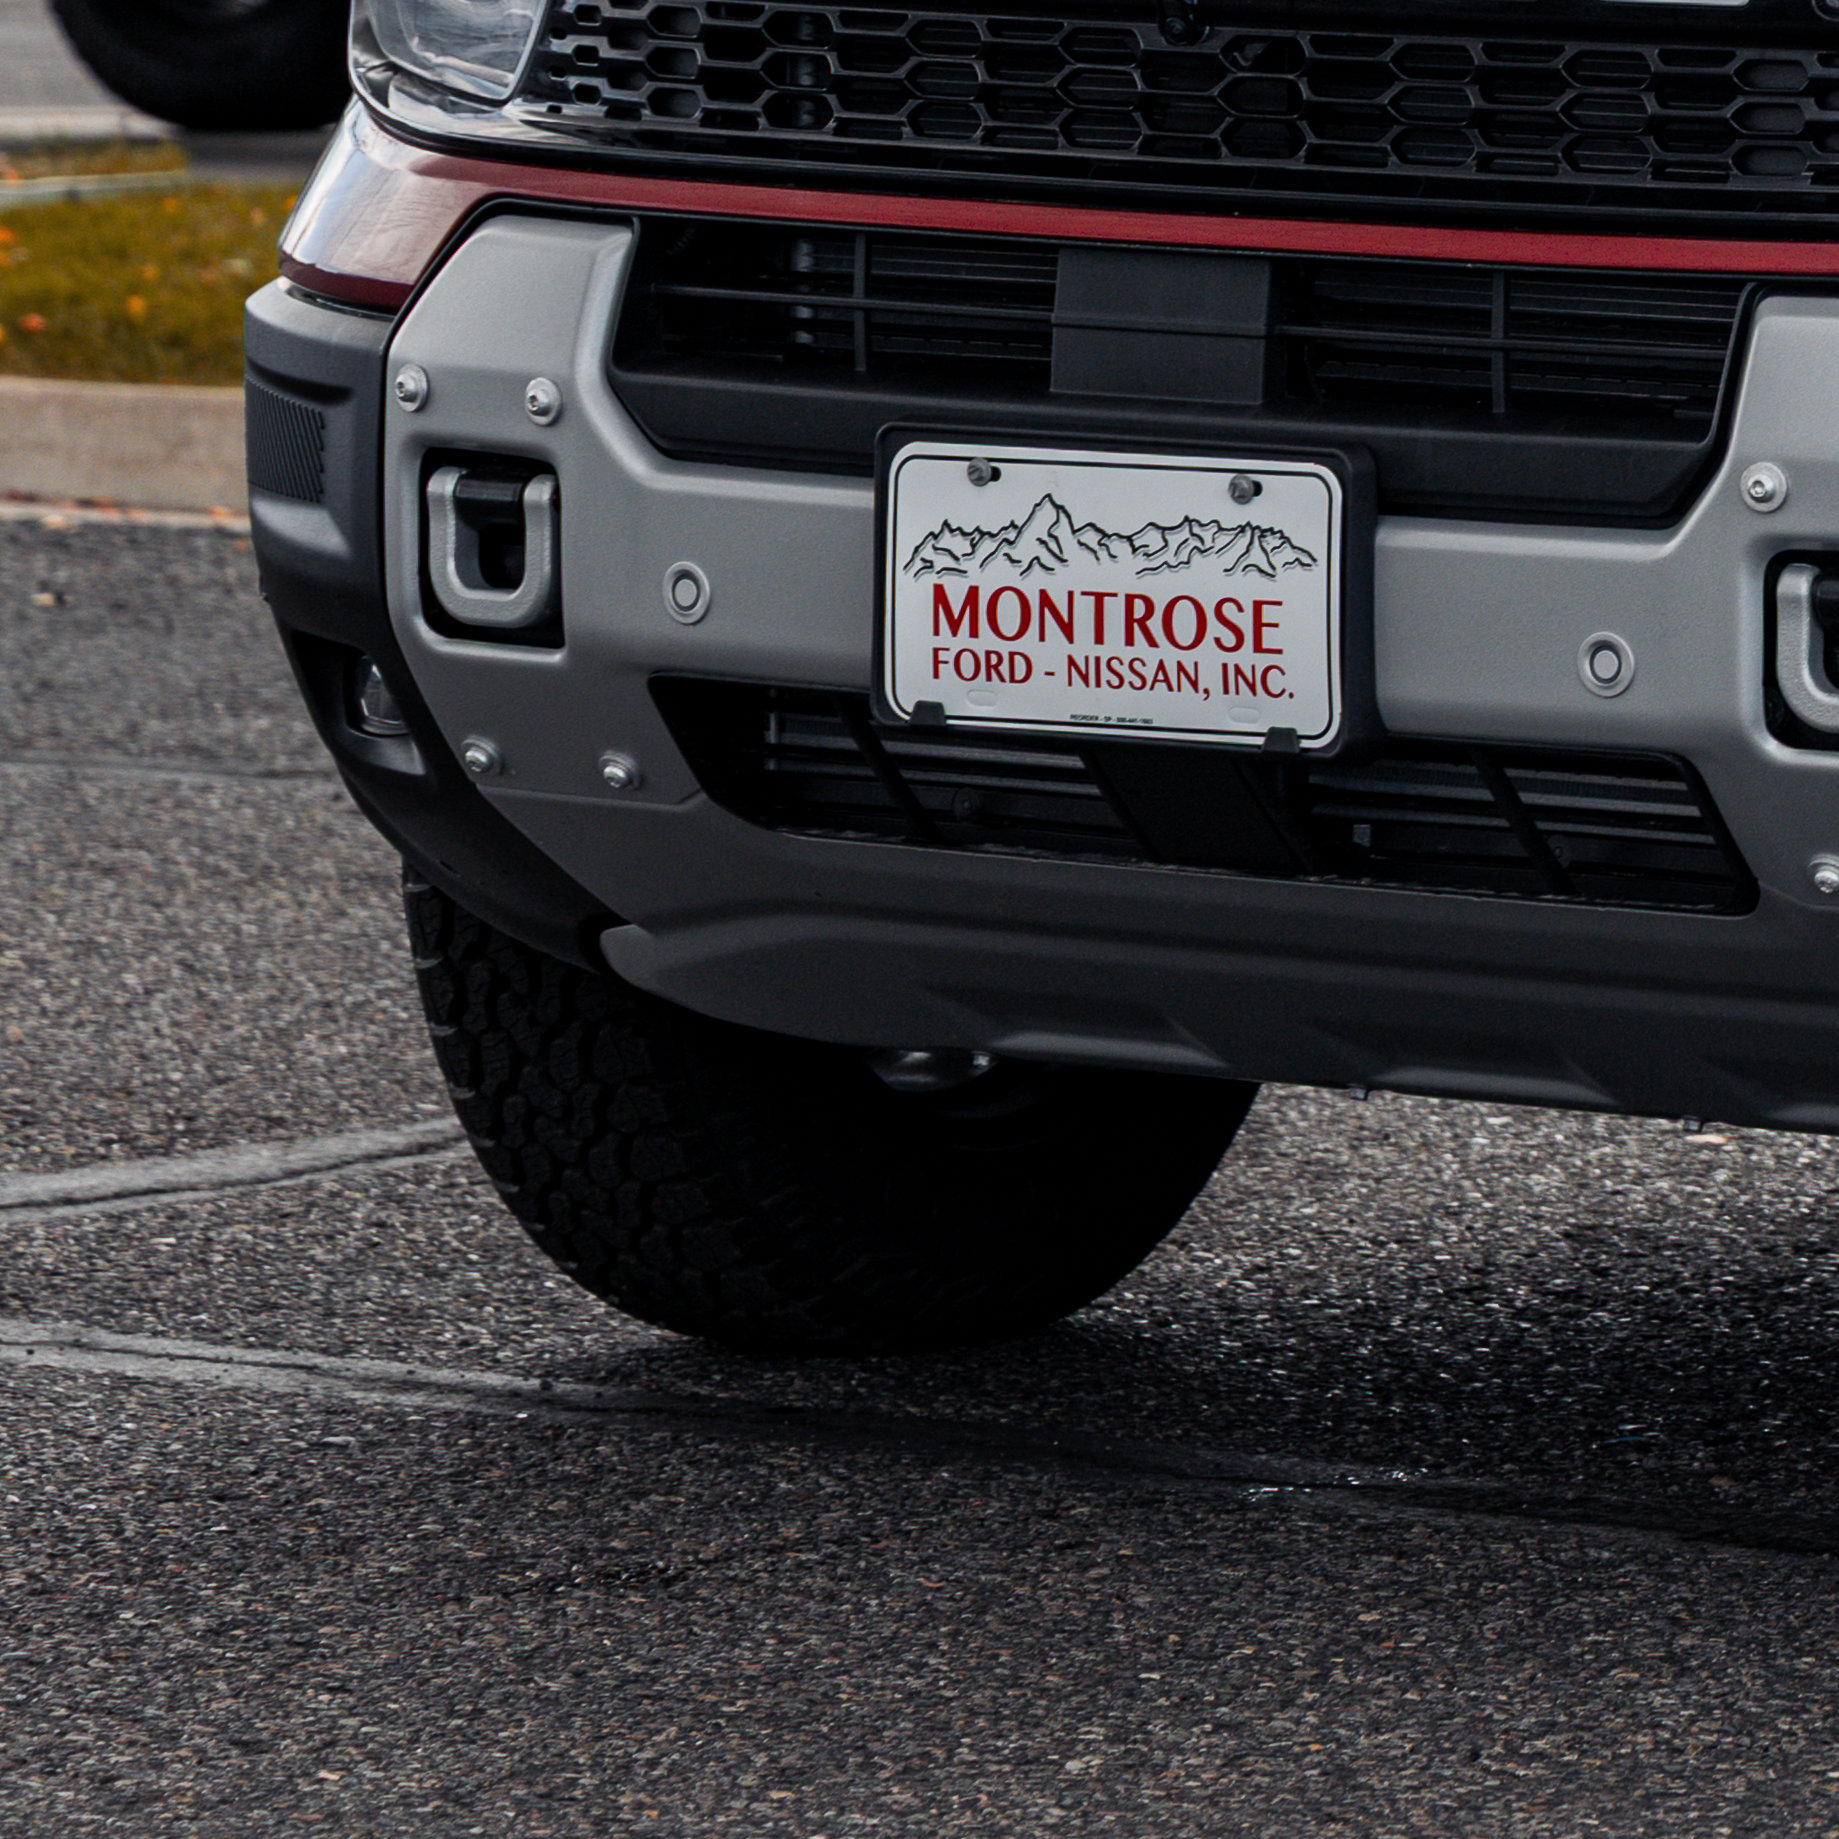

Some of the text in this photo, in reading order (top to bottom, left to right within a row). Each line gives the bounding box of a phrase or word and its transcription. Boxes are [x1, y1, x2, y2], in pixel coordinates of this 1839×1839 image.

[932, 582, 1284, 654] MONTROSE
[932, 646, 1034, 685] FORD
[1066, 654, 1212, 701] NISSAN,
[1221, 661, 1296, 700] INC.
